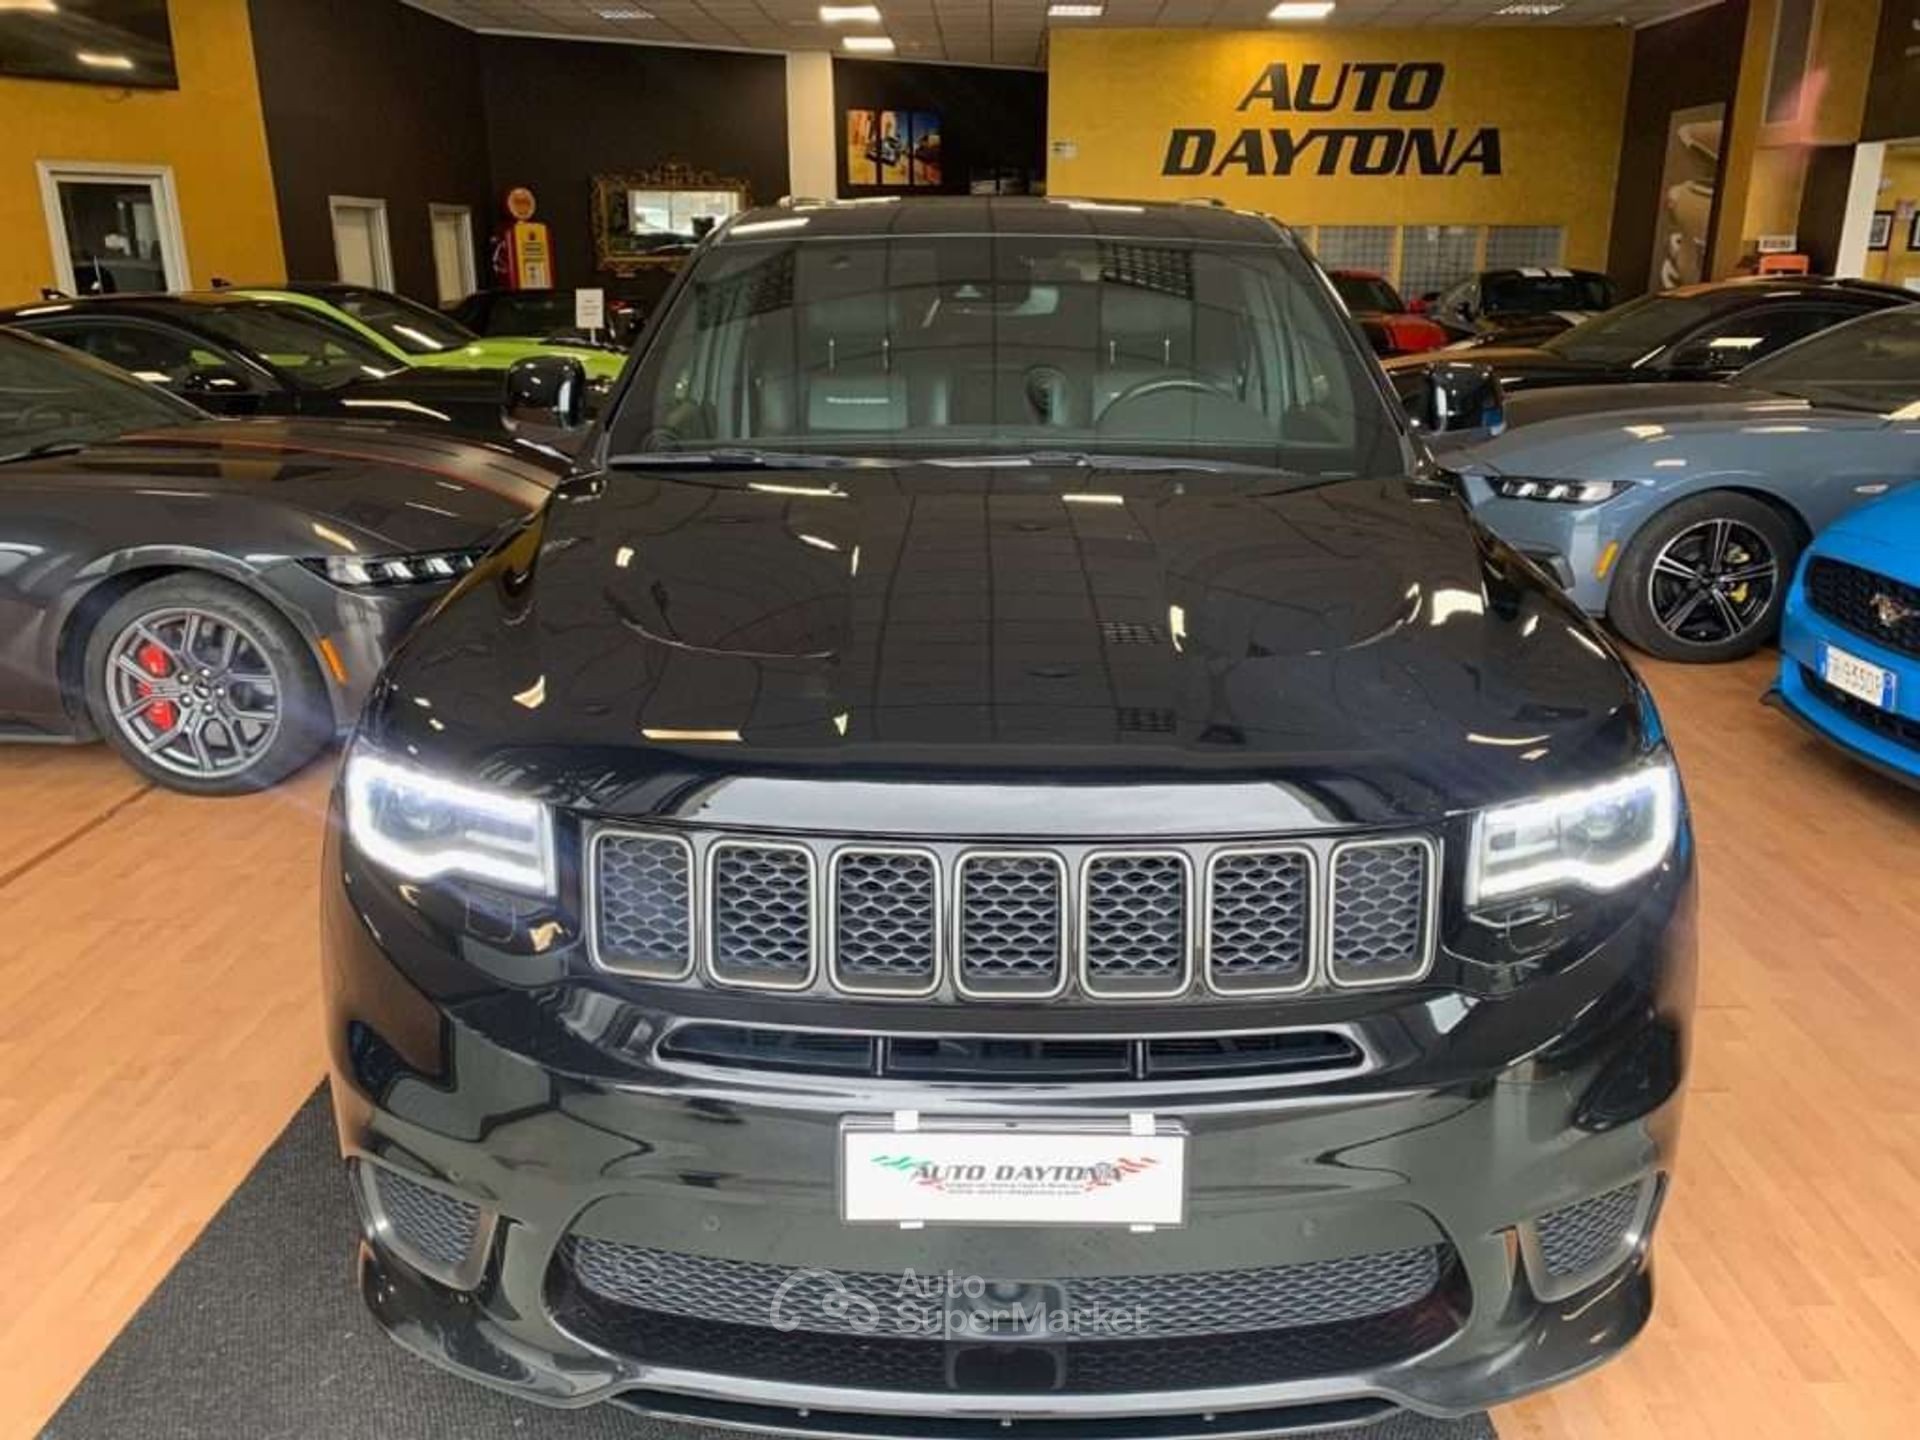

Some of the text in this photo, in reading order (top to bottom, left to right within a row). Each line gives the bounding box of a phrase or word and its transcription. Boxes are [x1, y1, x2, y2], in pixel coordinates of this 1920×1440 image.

[1236, 63, 1445, 112] AUTO
[1162, 128, 1502, 176] DAYTONA
[911, 1164, 985, 1181] AUTO
